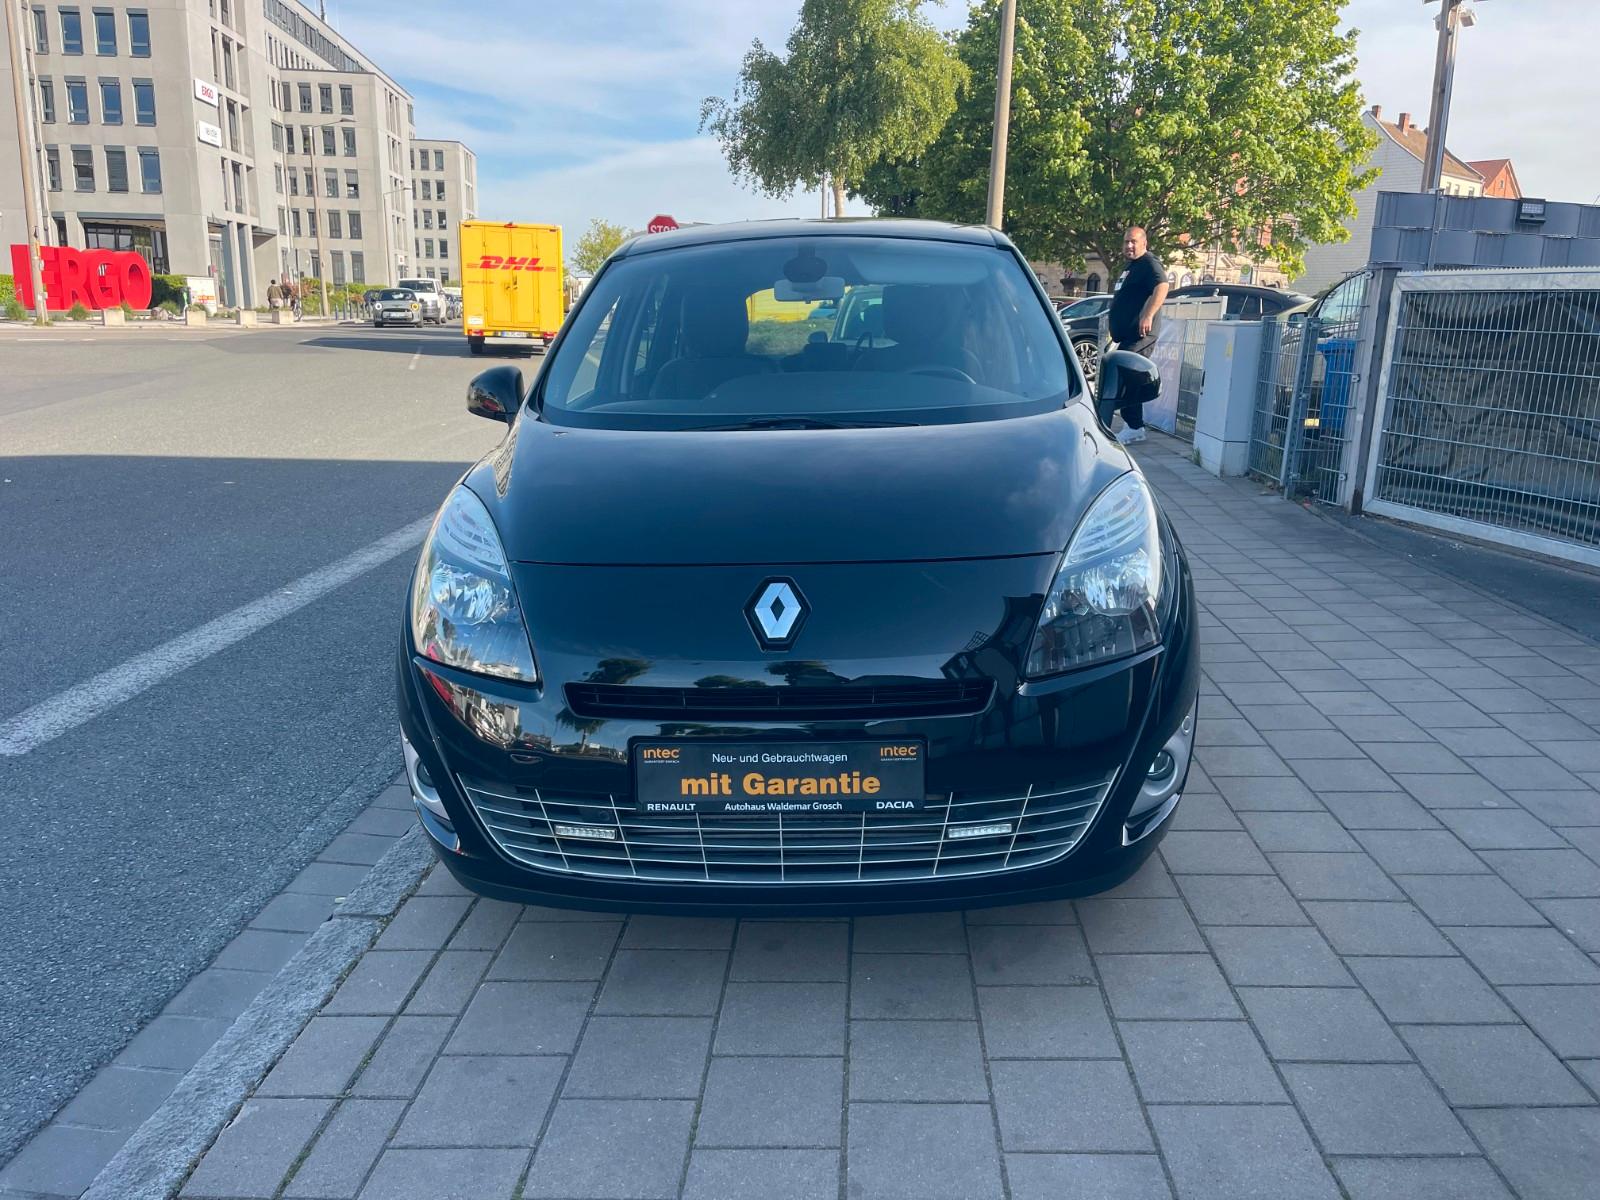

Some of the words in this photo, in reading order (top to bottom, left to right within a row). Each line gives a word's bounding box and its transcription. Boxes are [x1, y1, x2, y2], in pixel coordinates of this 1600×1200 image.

[201, 86, 214, 100] ERGO
[480, 256, 544, 271] DHL
[11, 244, 152, 310] ERGO
[643, 748, 680, 759] intec
[880, 746, 917, 756] intec
[712, 754, 737, 763] Neu-
[739, 753, 759, 763] und
[761, 753, 848, 765] Gebrauchtwagen
[681, 772, 731, 795] mit
[742, 771, 881, 795] Garantie
[647, 803, 696, 811] RENAULT
[724, 802, 765, 811] Autohaus
[767, 802, 811, 811] Waldemar
[812, 802, 842, 811] Grosch
[876, 801, 914, 809] DACIA
